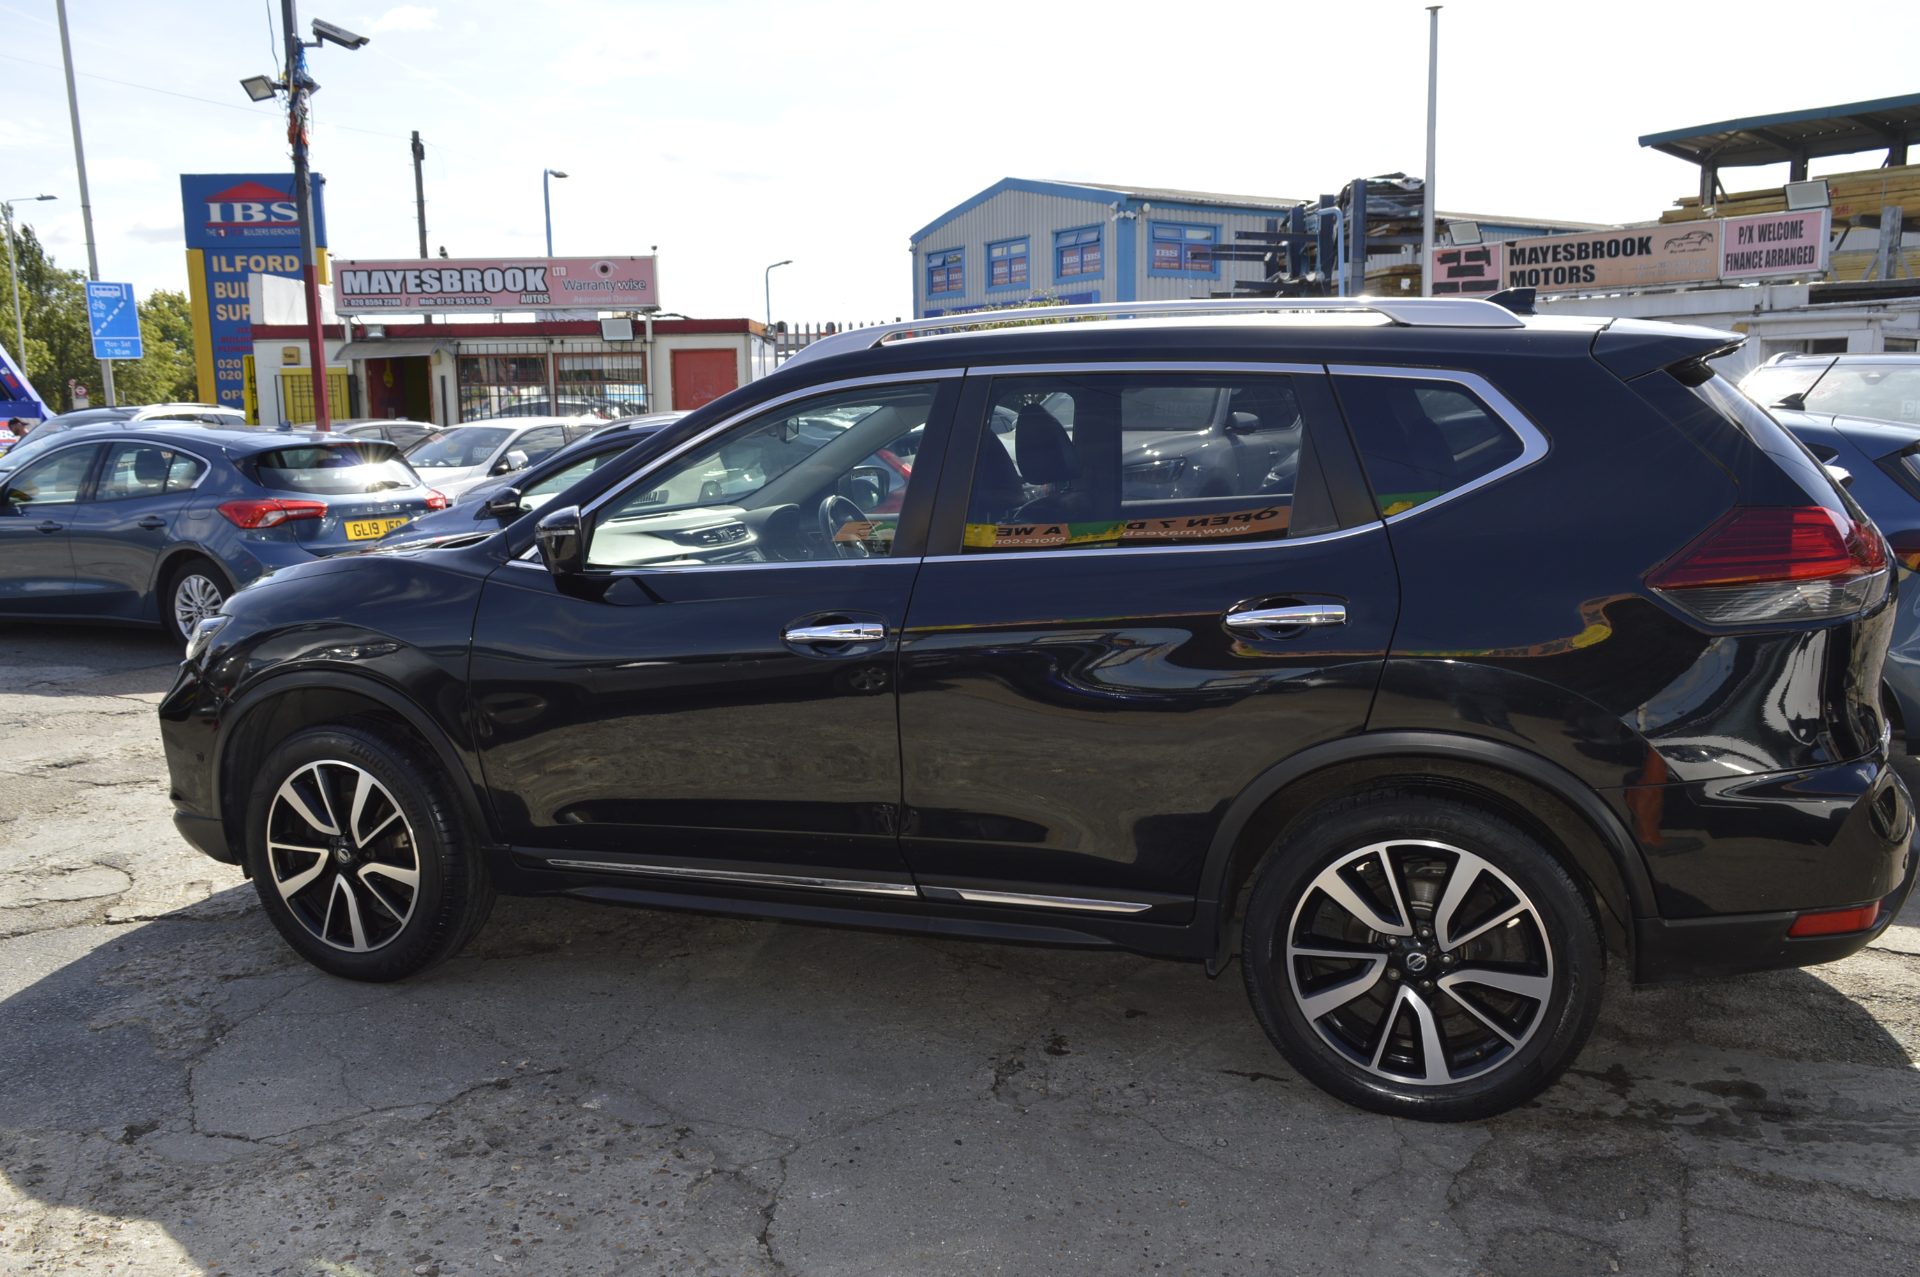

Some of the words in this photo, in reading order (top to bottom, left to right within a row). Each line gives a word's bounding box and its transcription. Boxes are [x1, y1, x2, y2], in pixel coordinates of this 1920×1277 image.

[205, 201, 299, 223] IBS
[1738, 225, 1754, 245] P/X
[1758, 219, 1804, 243] WELCOME
[1509, 235, 1653, 266] MAYESBROOK
[1725, 250, 1763, 272] FINANCE
[1764, 245, 1815, 268] ARRANGED
[212, 254, 300, 273] ILFORD
[552, 266, 567, 277] LTD
[341, 266, 549, 295] MAYESBROOK
[1509, 264, 1596, 288] MOTORS
[214, 281, 249, 299] BUI
[520, 293, 550, 304] AUTOS
[218, 359, 241, 369] 020
[219, 370, 242, 380] 020
[222, 390, 244, 400] OP
[352, 521, 380, 537] GL19
